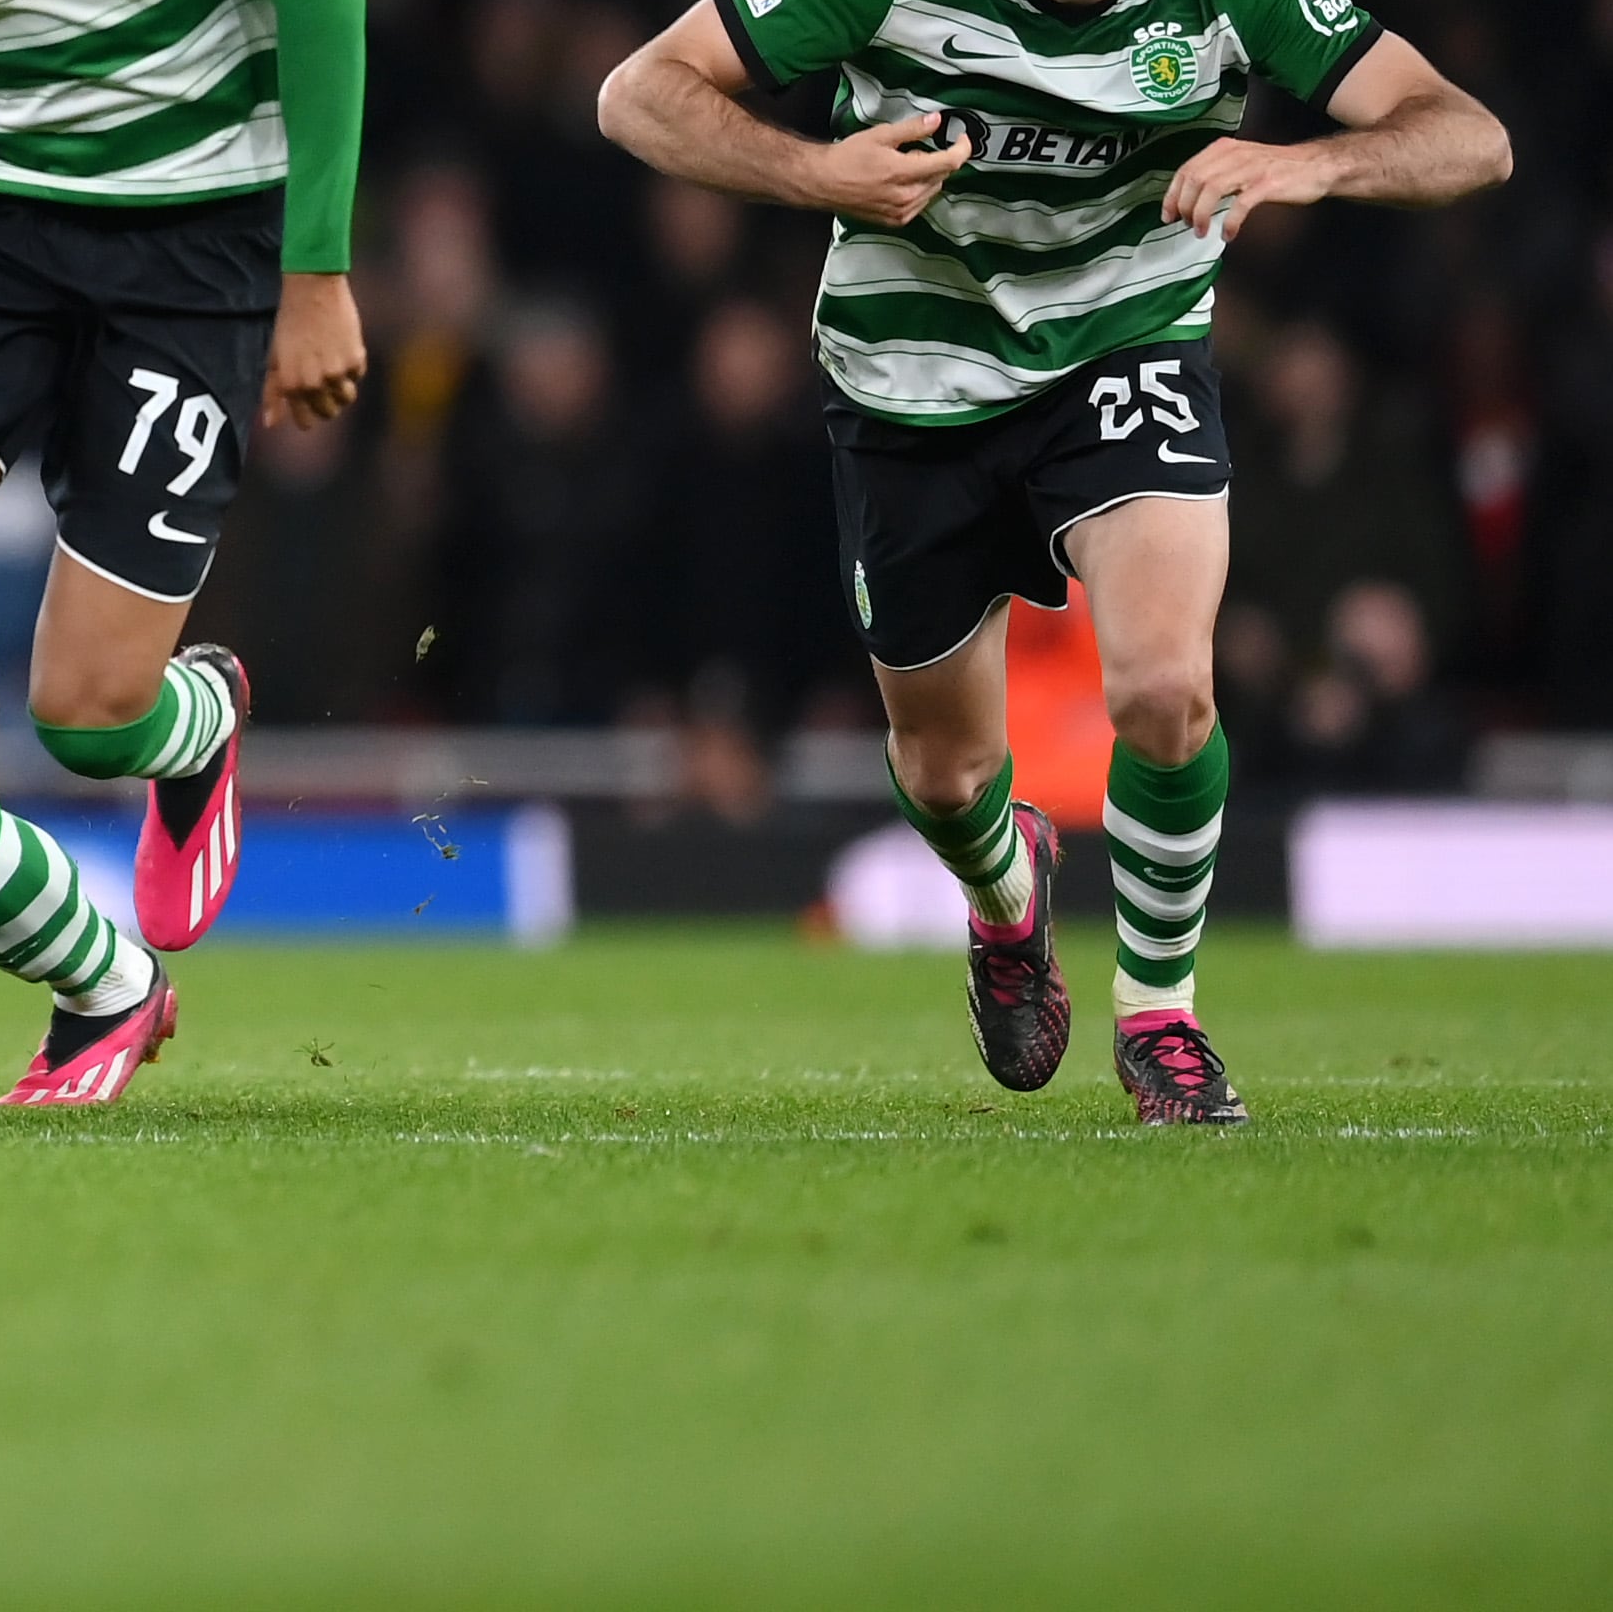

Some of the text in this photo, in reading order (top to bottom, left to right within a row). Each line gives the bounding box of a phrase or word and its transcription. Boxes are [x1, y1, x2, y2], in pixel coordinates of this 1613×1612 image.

[1133, 21, 1183, 44] SCP
[1135, 41, 1187, 63] SPORTING
[1088, 359, 1200, 440] 25
[118, 367, 228, 497] 79
